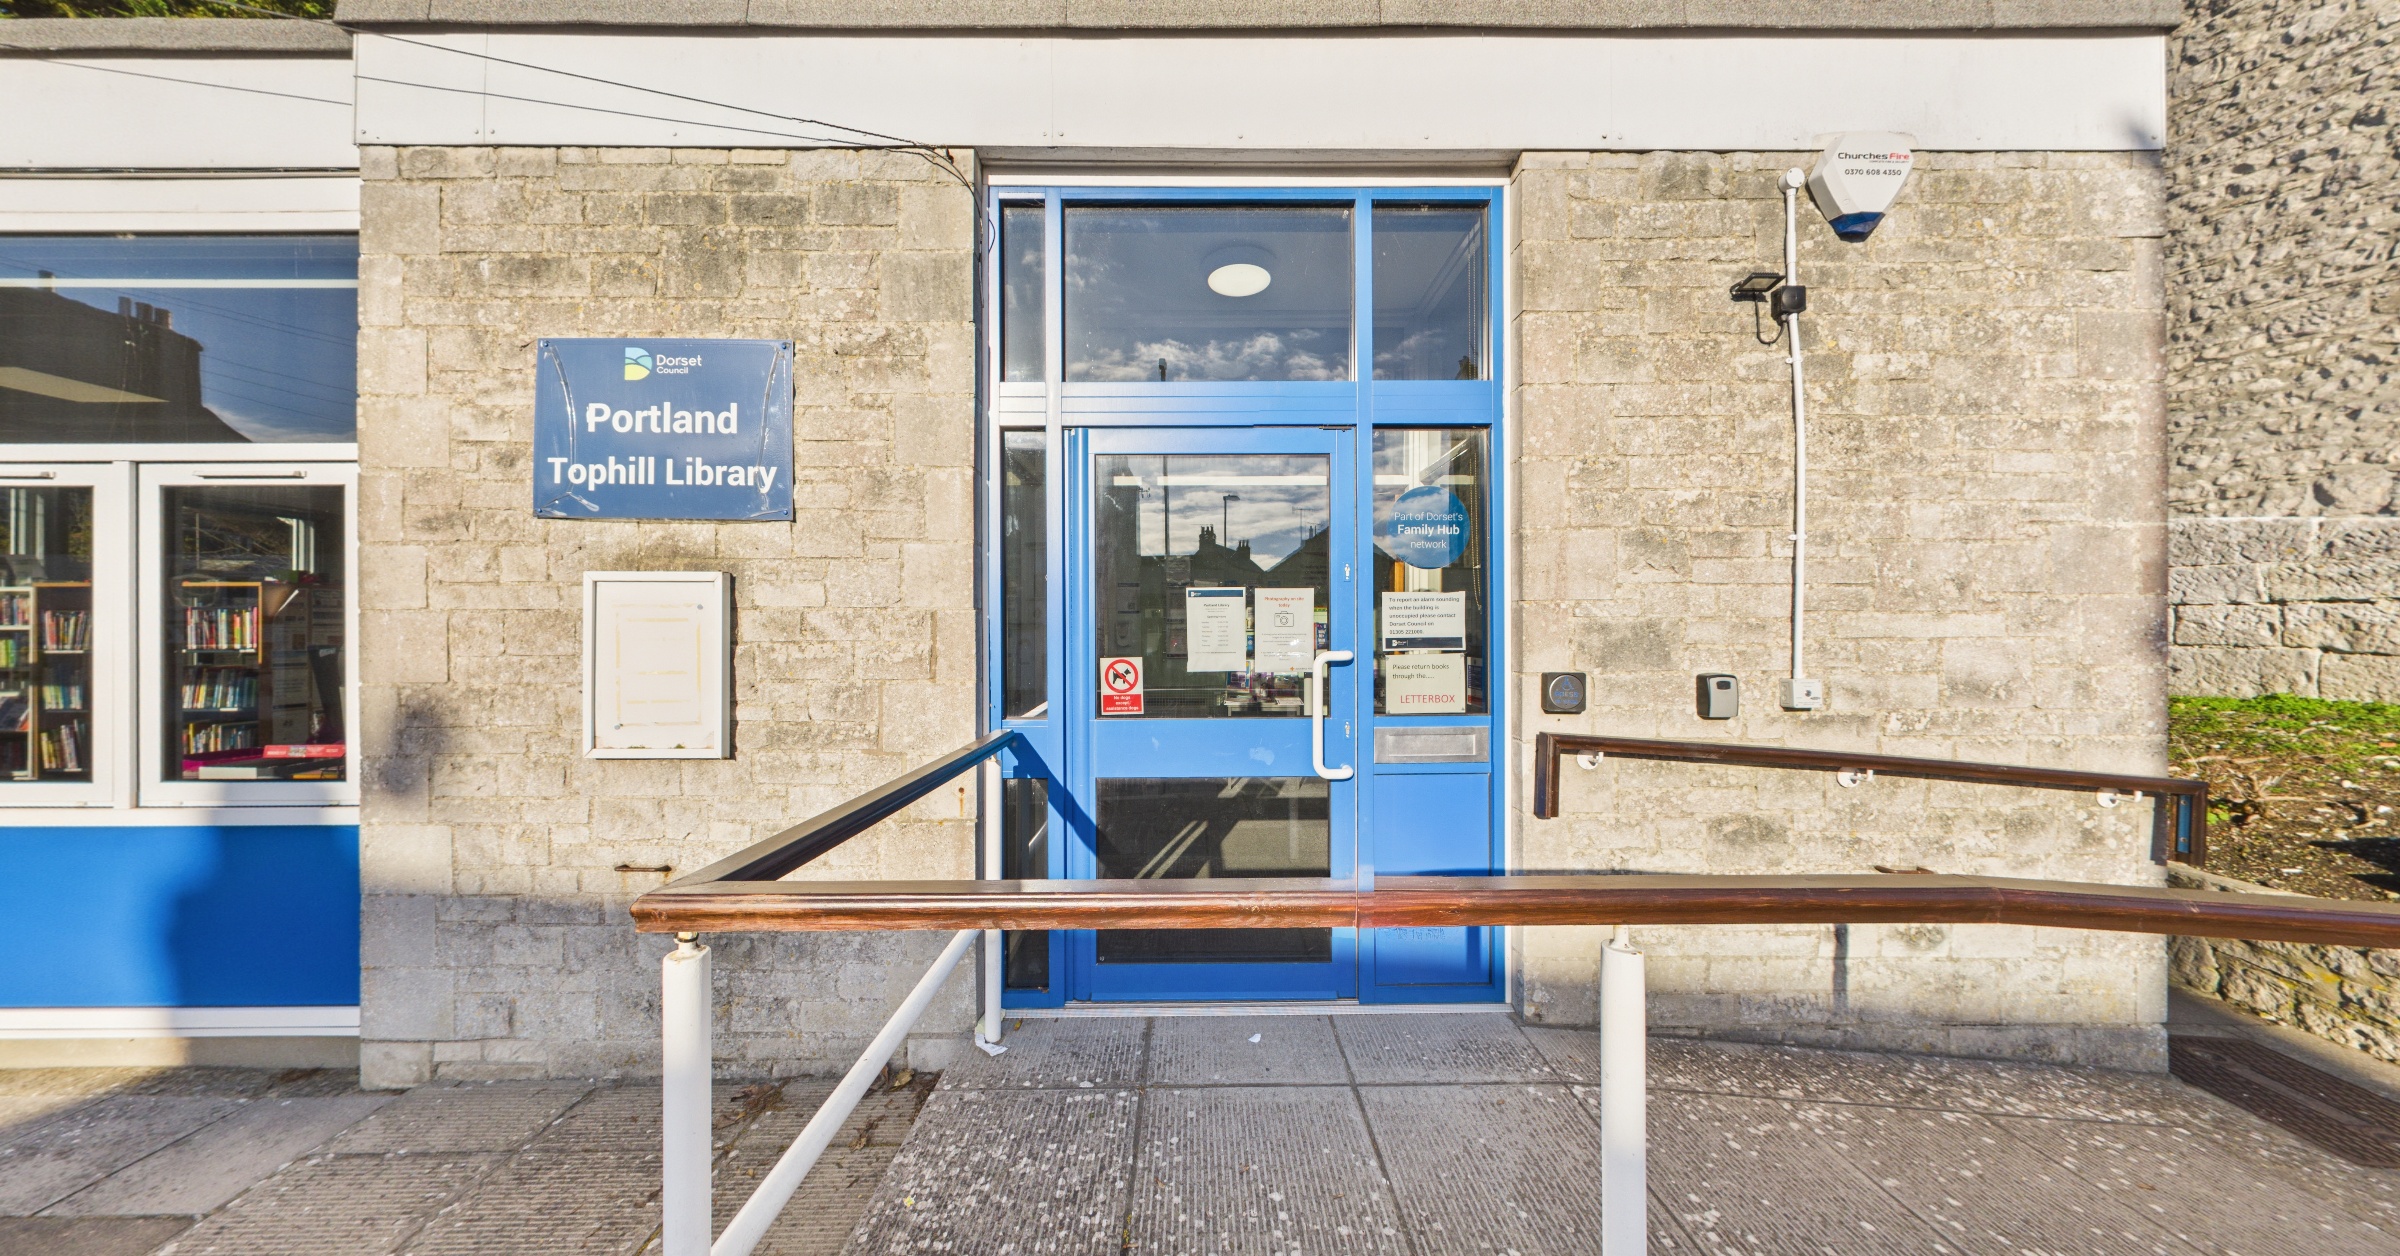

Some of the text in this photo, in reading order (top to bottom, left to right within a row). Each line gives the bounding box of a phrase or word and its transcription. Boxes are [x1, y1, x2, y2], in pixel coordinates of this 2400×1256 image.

[656, 354, 702, 367] Dorset
[656, 366, 689, 374] Council
[587, 401, 738, 434] Portland
[547, 456, 778, 494] Tophill Library
[1394, 512, 1463, 521] Part of Dorset's
[1397, 524, 1460, 537] Family Hub
[1410, 540, 1447, 549] network
[1400, 694, 1456, 704] LETTERBOX
